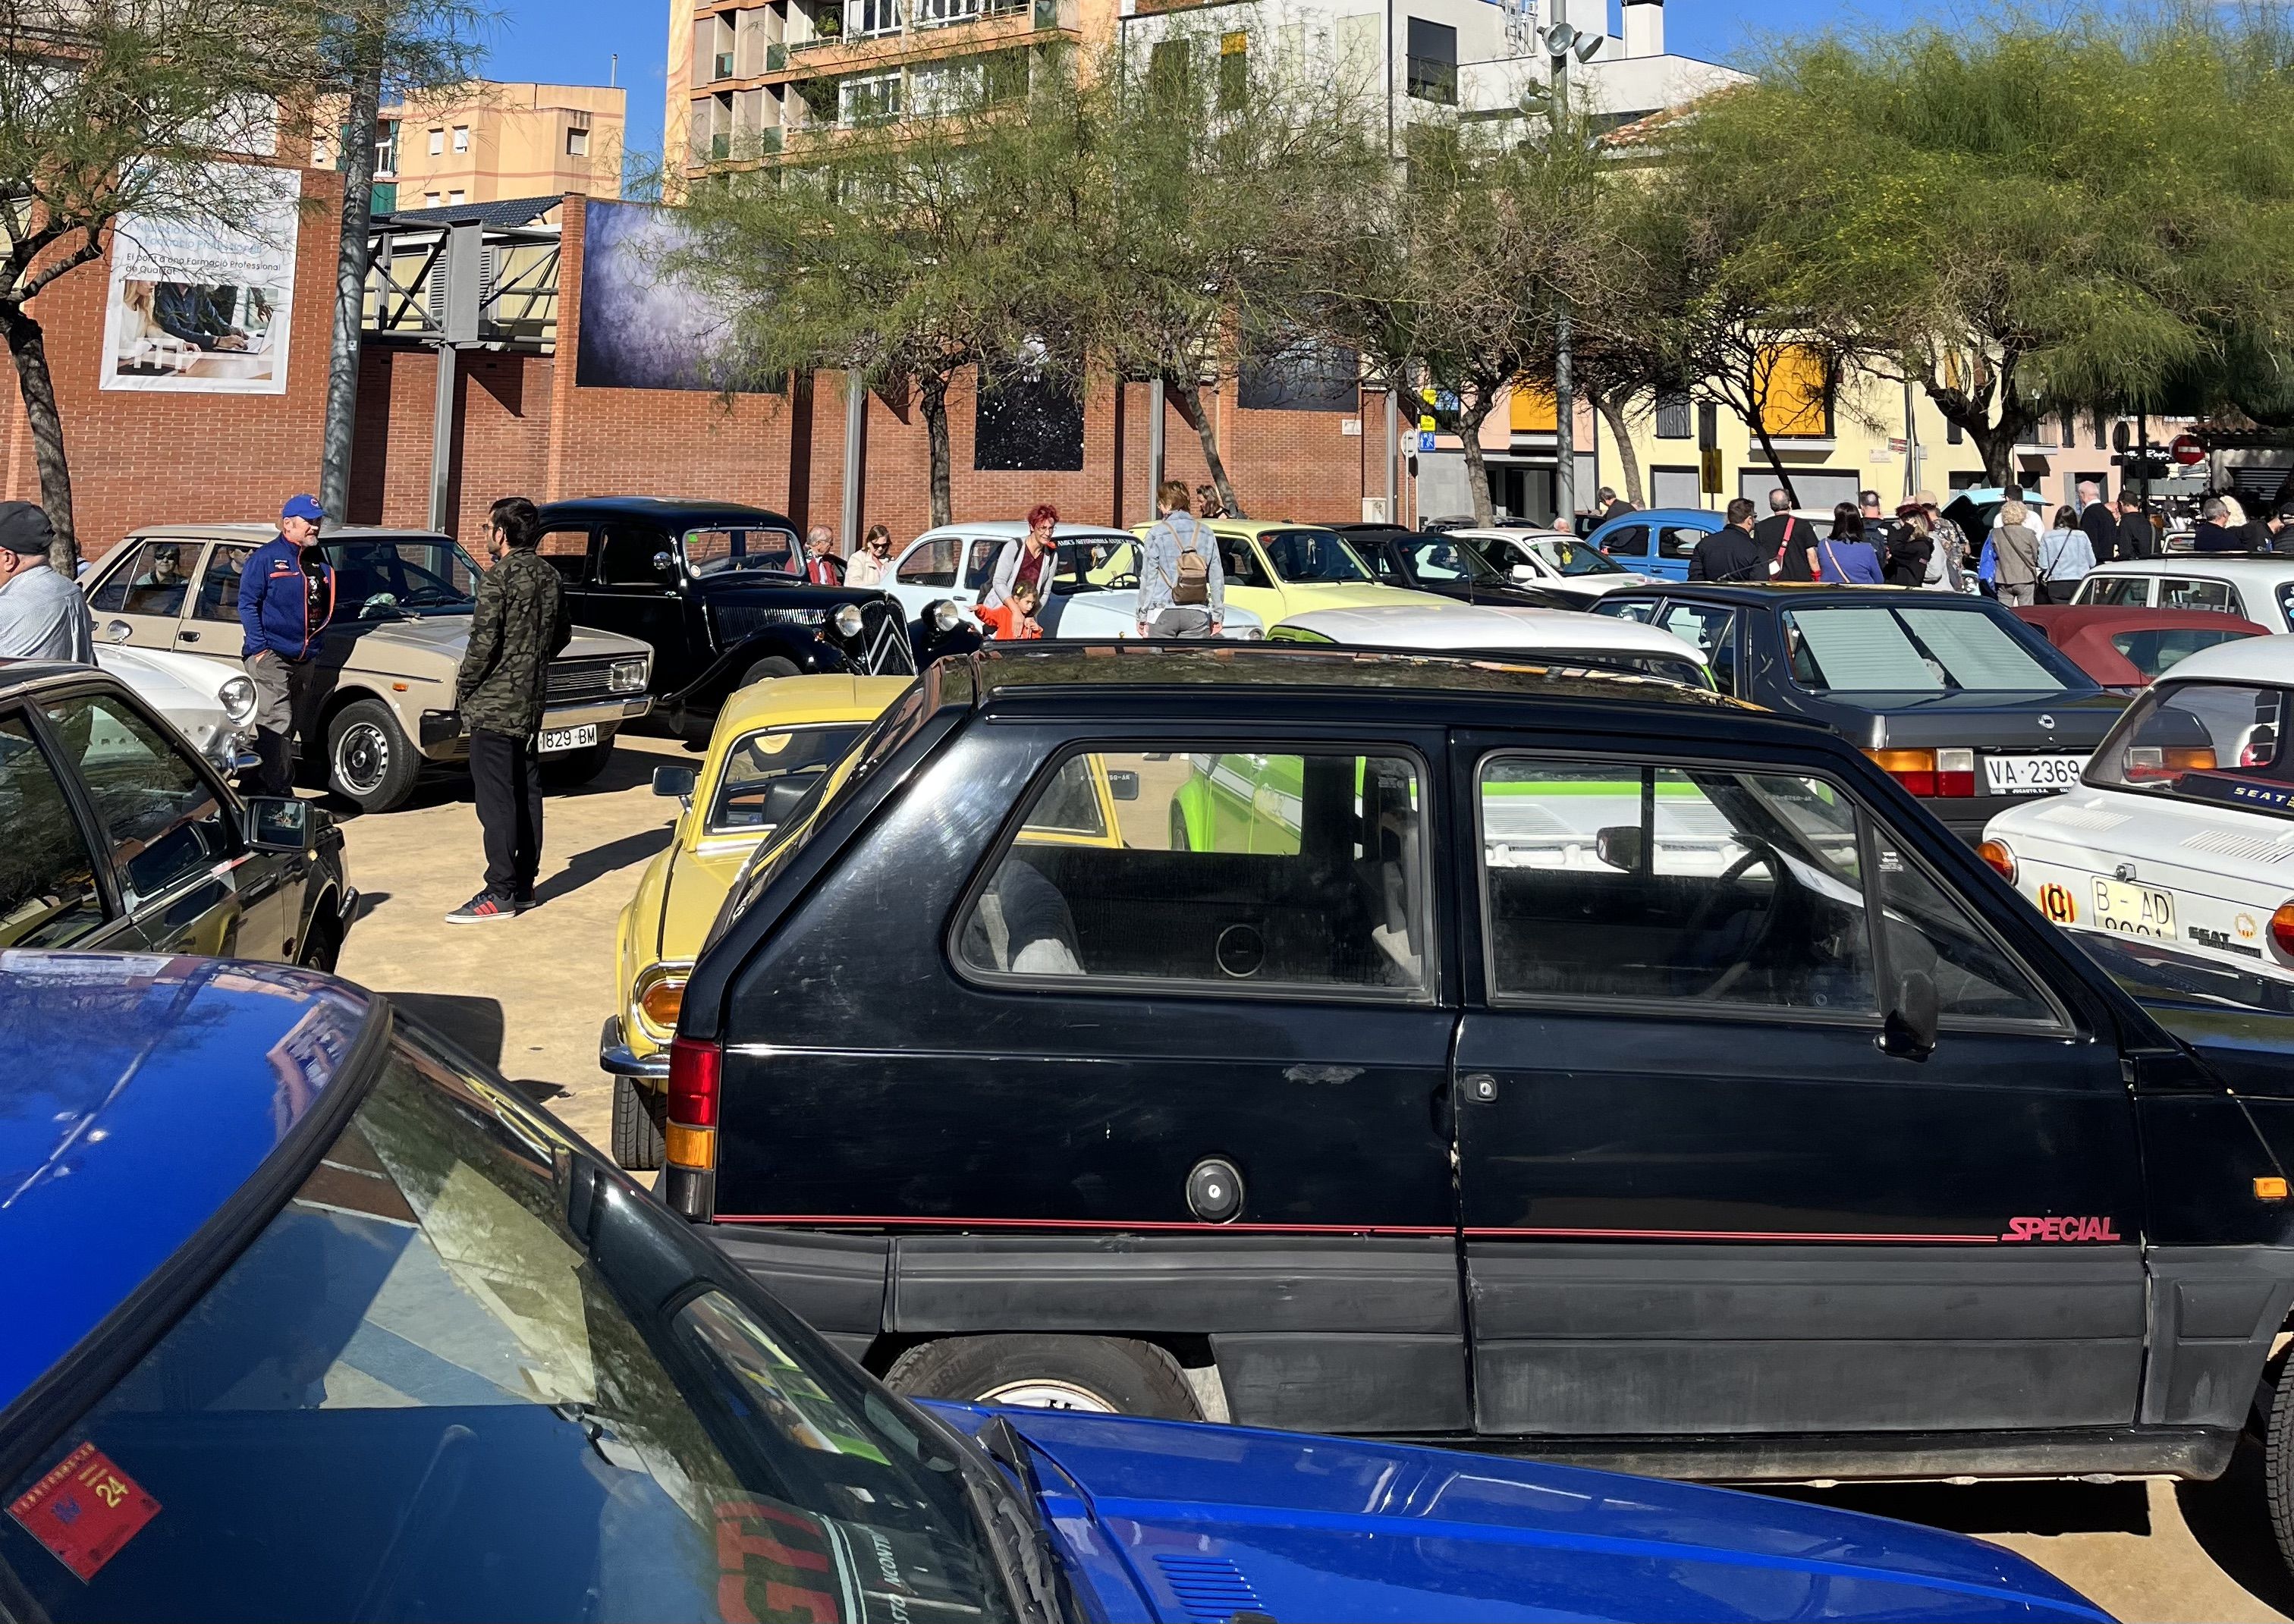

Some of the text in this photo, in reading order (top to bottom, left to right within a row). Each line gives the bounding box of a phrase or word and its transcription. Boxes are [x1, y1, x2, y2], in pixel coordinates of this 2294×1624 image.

[187, 256, 228, 267] Formació
[230, 260, 281, 271] Professional
[2233, 787, 2286, 803] SEAT
[2047, 887, 2066, 917] C
[2001, 1217, 2120, 1242] SPECIAL
[96, 1476, 129, 1508] 24
